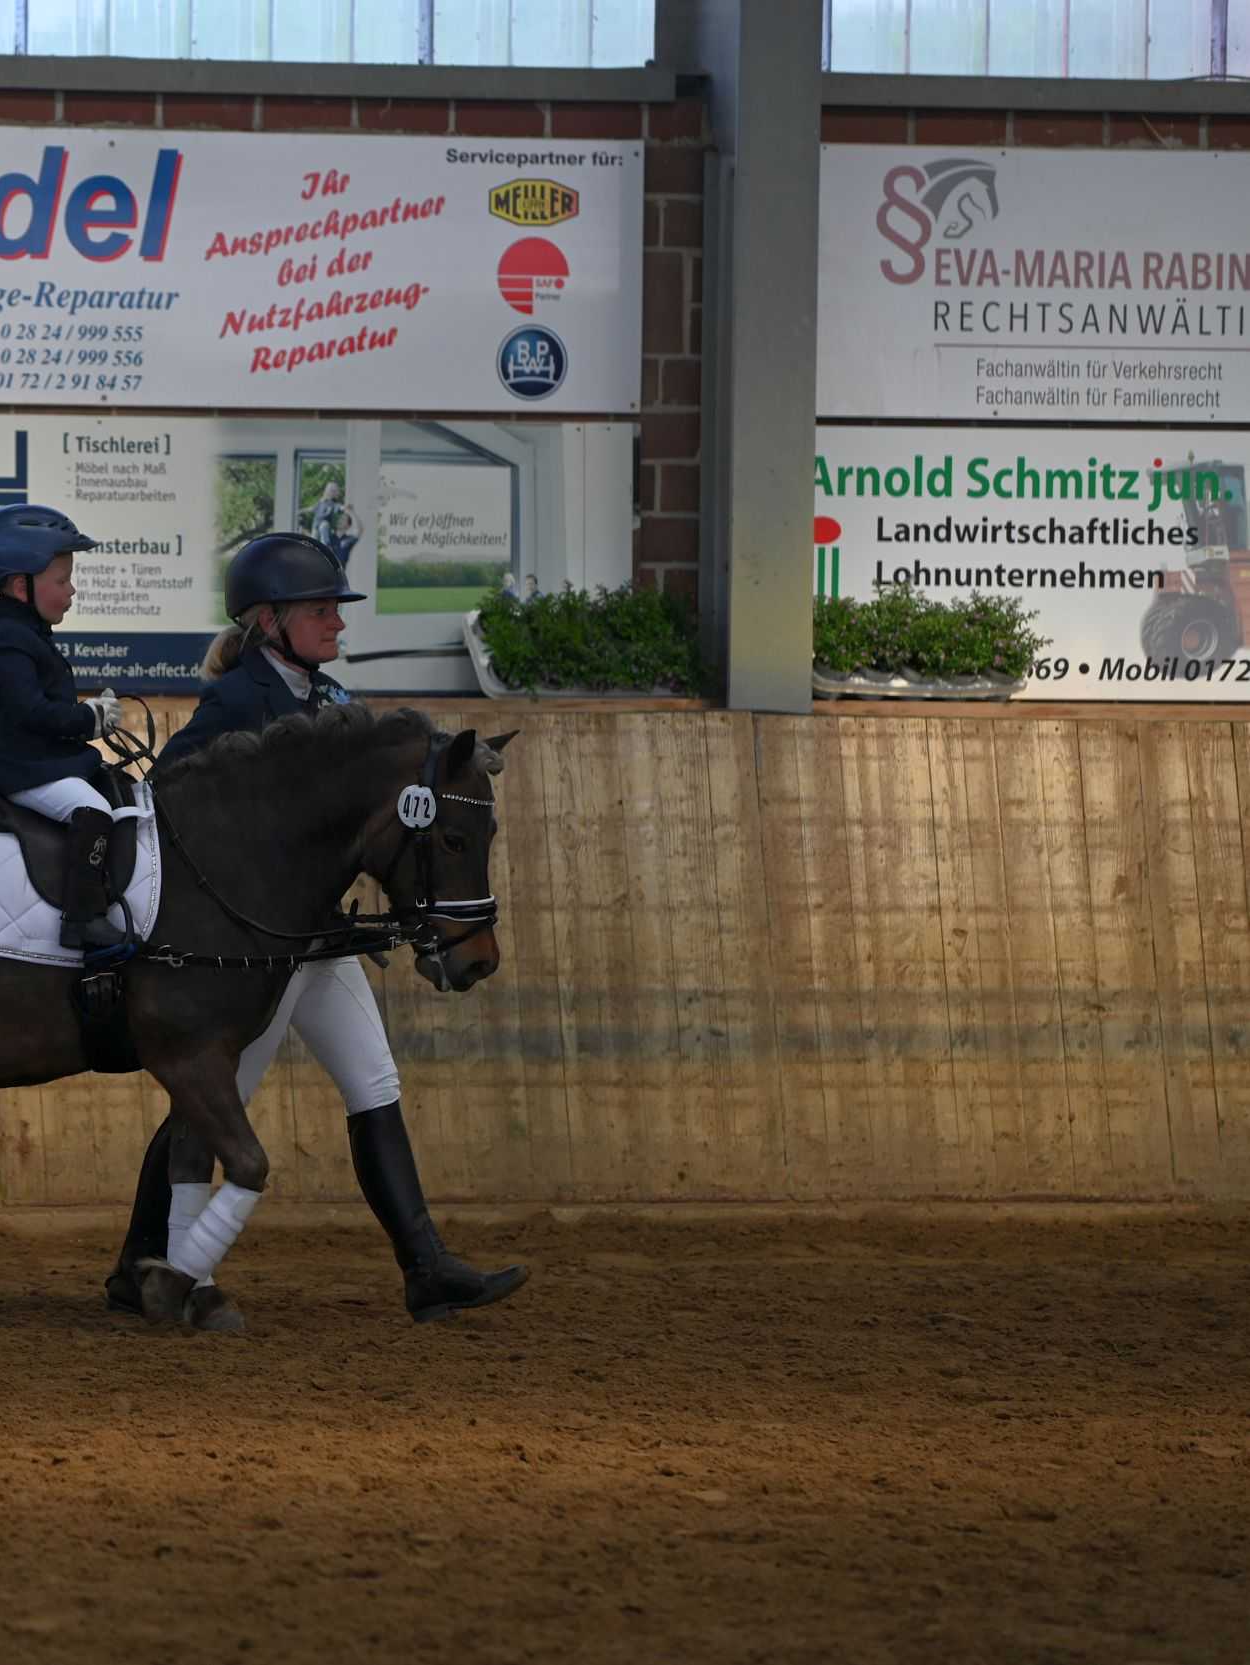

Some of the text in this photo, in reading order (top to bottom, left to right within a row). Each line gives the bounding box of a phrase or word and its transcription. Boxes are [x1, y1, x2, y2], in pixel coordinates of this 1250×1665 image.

[446, 148, 623, 168] Servicepartner für:
[301, 168, 350, 200] Ihr
[205, 195, 446, 261] Ansprechpartner
[278, 247, 373, 287] bei der
[934, 248, 1250, 291] EVA-MARIA RABIN
[219, 282, 430, 339] Nutzfahrzeug-
[934, 297, 1244, 336] RECHTSANWÄLTI
[1, 323, 12, 340] 0
[16, 323, 37, 340] 28
[41, 323, 62, 341] 24
[78, 325, 108, 342] 999
[112, 325, 143, 343] 555
[1, 347, 12, 364] 0
[16, 348, 37, 365] 28
[41, 348, 62, 365] 24
[78, 349, 108, 366] 999
[112, 349, 143, 367] 556
[250, 326, 398, 373] Reparatur
[976, 358, 1222, 381] Fachanwältin für Verkehrsrecht
[21, 373, 40, 390] 72
[72, 374, 91, 391] 91
[96, 374, 117, 392] 84
[121, 374, 142, 392] 57
[976, 386, 1220, 408] Fachanwältin für Familienrecht
[76, 436, 159, 454] Tischlerei
[75, 462, 108, 475] Möbel
[113, 462, 139, 475] nach
[144, 462, 166, 475] Maß
[75, 476, 148, 488] Innenausbau
[814, 455, 1233, 512] Arnold Schmitz jun.
[75, 489, 176, 502] Reparaturarbeiten
[390, 512, 474, 529] Wir (er)öffnen
[390, 532, 507, 548] neue Möglichkeiten!
[877, 516, 1199, 547] Landwirtschaftliches
[75, 562, 116, 575] Fenster
[132, 562, 161, 575] Türen
[876, 560, 1165, 589] Lohnunternehmen
[92, 577, 116, 589] Holz
[136, 577, 193, 590] Kunststoff
[76, 591, 149, 604] Wintergärten
[76, 604, 161, 616] Insektenschutz
[74, 642, 129, 657] Kevelaer
[1028, 658, 1070, 681] 69
[1099, 657, 1178, 681] Mobil
[1184, 659, 1250, 682] 0172
[402, 794, 430, 818] 472
